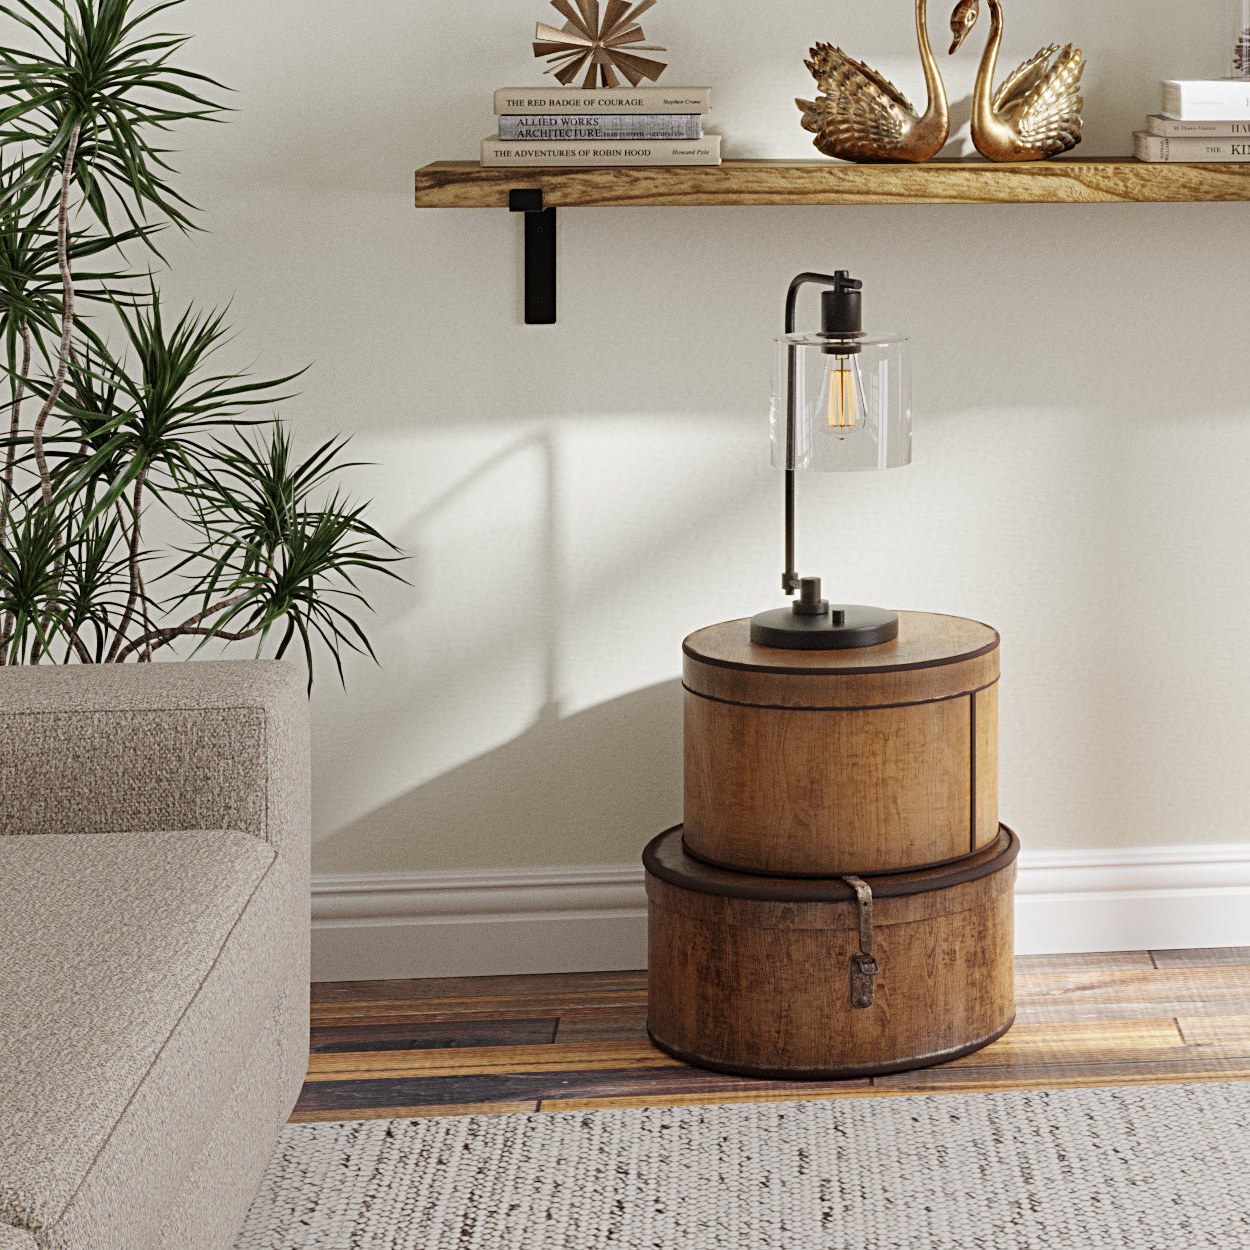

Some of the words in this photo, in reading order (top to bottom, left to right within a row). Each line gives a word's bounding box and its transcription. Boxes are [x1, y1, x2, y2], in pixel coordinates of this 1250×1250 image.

[549, 99, 581, 107] BADGE
[584, 99, 596, 107] OF
[599, 99, 644, 107] COURAGE
[517, 118, 557, 127] ALLIED
[560, 118, 599, 126] WORKS
[494, 150, 512, 158] THE
[514, 150, 576, 158] ADVENTURES
[578, 149, 591, 157] OF
[593, 149, 622, 157] ROBIN
[624, 149, 651, 157] HOOD
